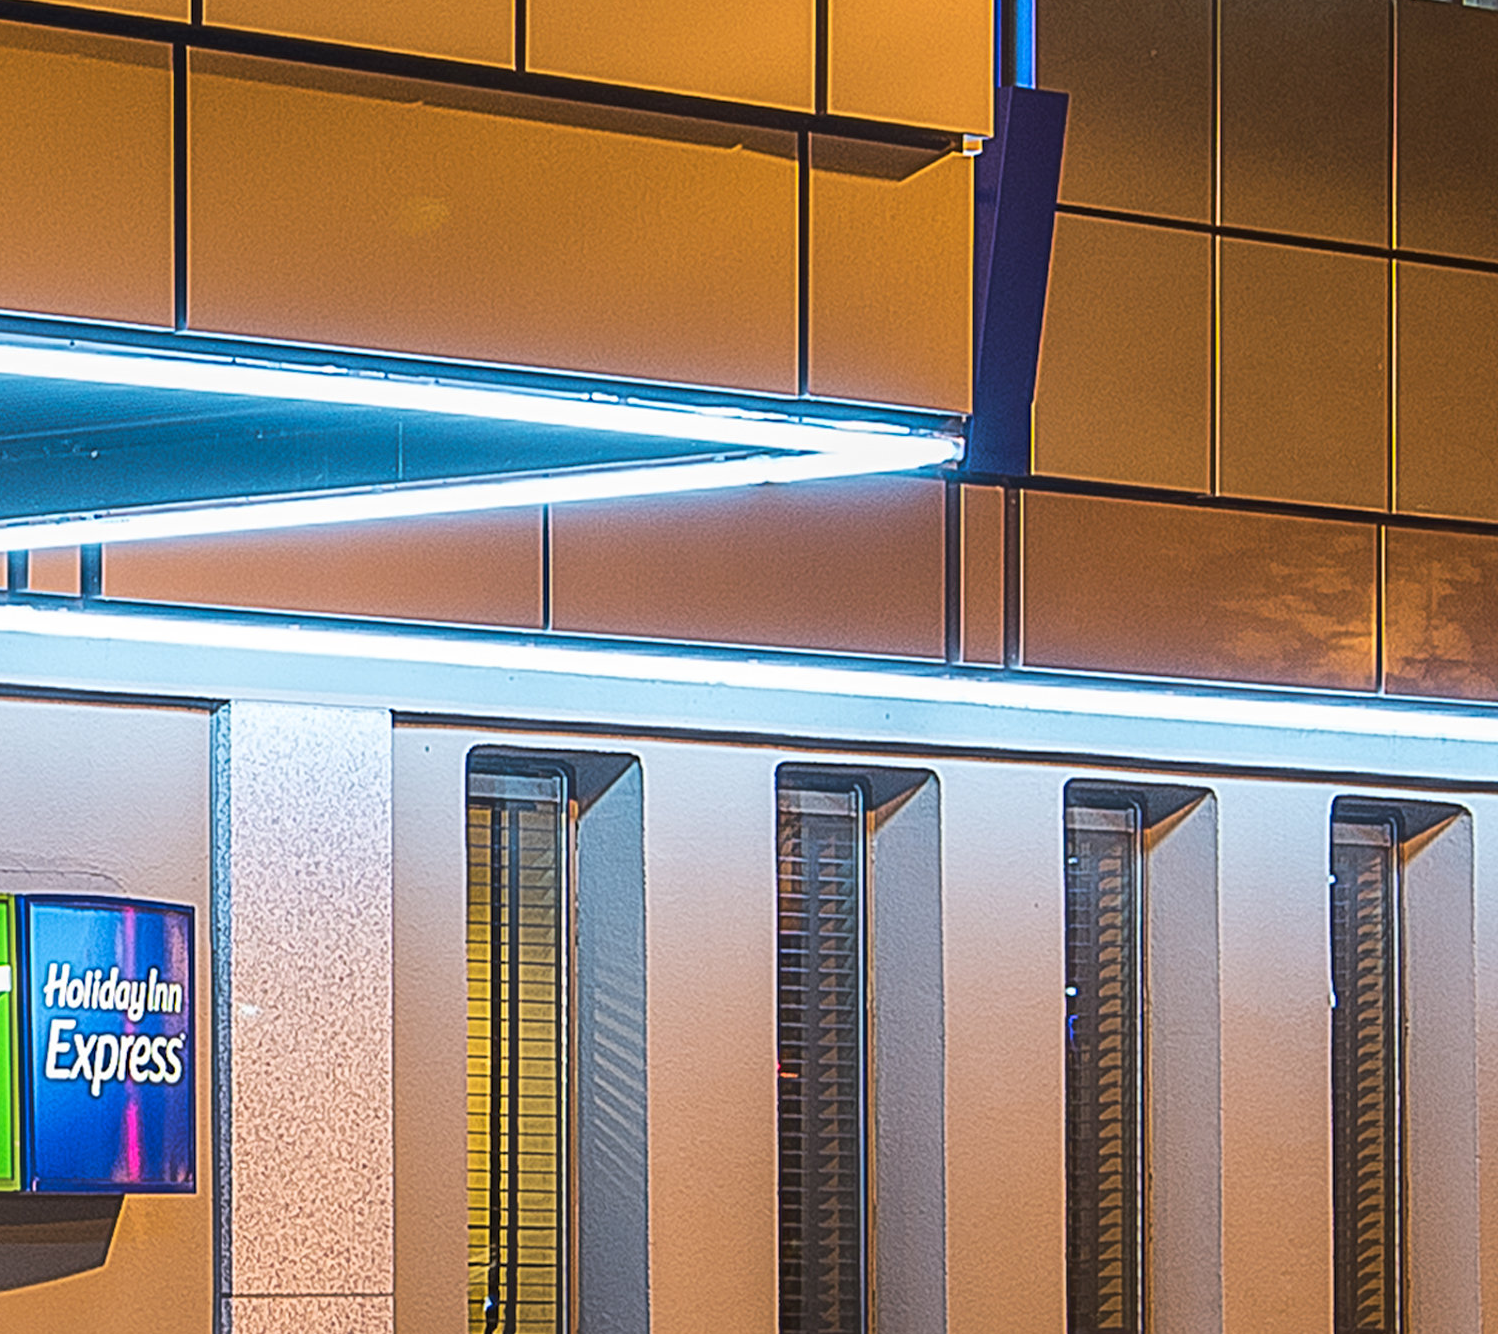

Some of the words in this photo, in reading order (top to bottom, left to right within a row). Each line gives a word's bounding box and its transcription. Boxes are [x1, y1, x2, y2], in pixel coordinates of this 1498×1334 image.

[43, 963, 146, 1021] Holiday
[147, 968, 183, 1013] Inn
[45, 1019, 184, 1097] Express
